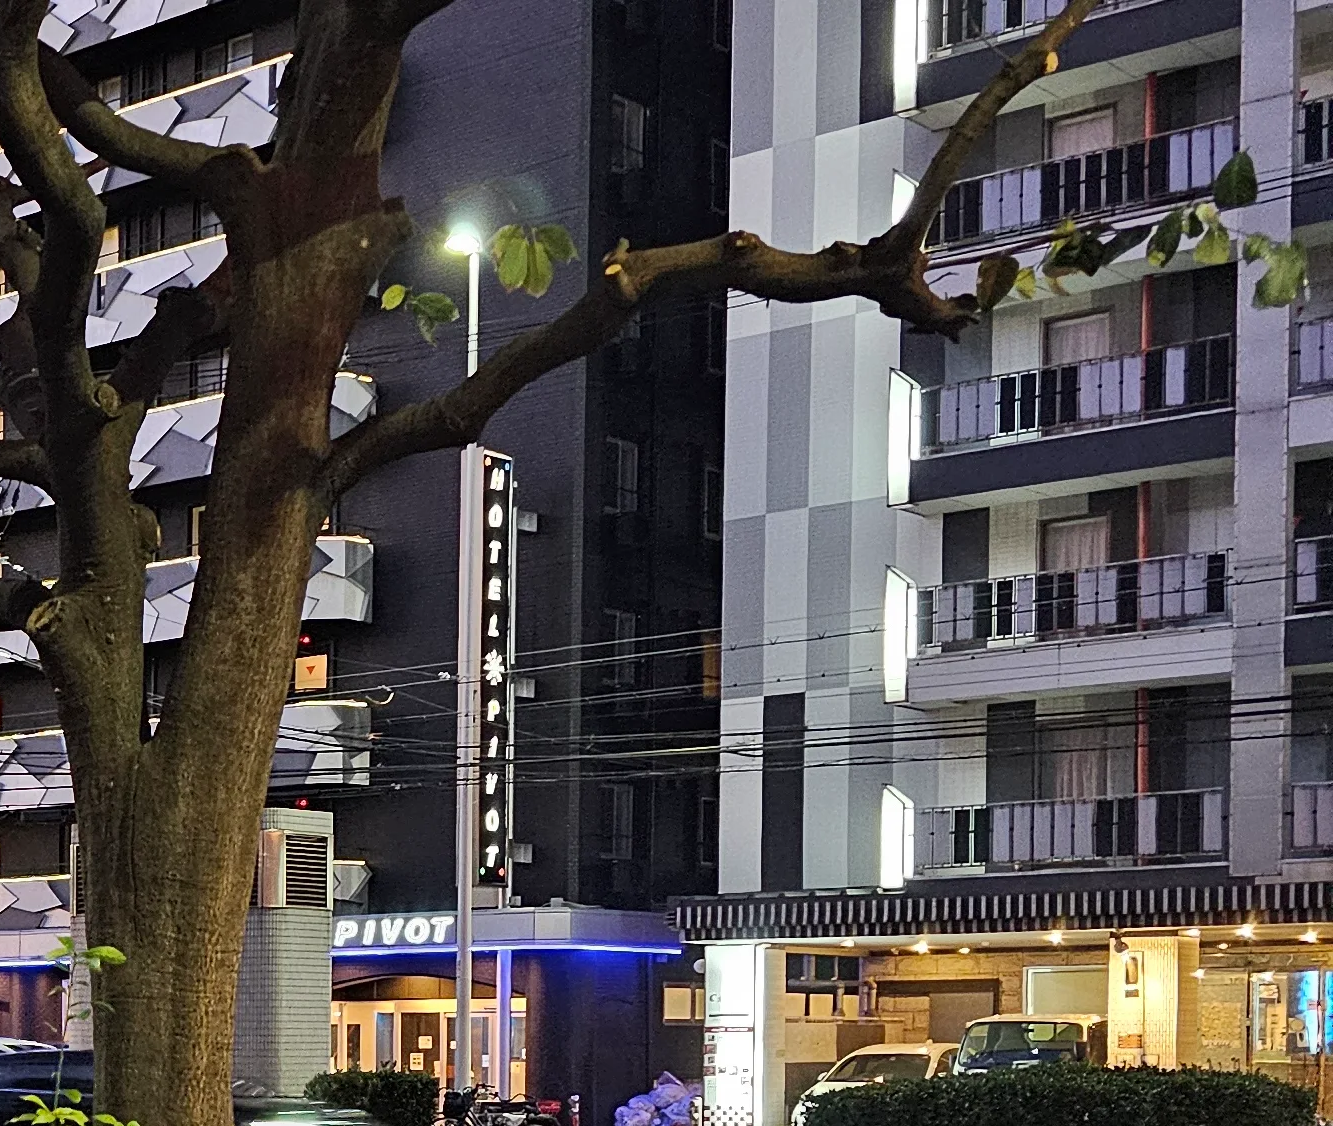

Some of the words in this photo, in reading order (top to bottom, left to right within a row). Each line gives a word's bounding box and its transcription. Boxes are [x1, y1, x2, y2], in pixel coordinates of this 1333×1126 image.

[488, 467, 506, 639] HOTEL
[485, 697, 501, 869] PIVOT
[333, 915, 455, 947] PIVOT
